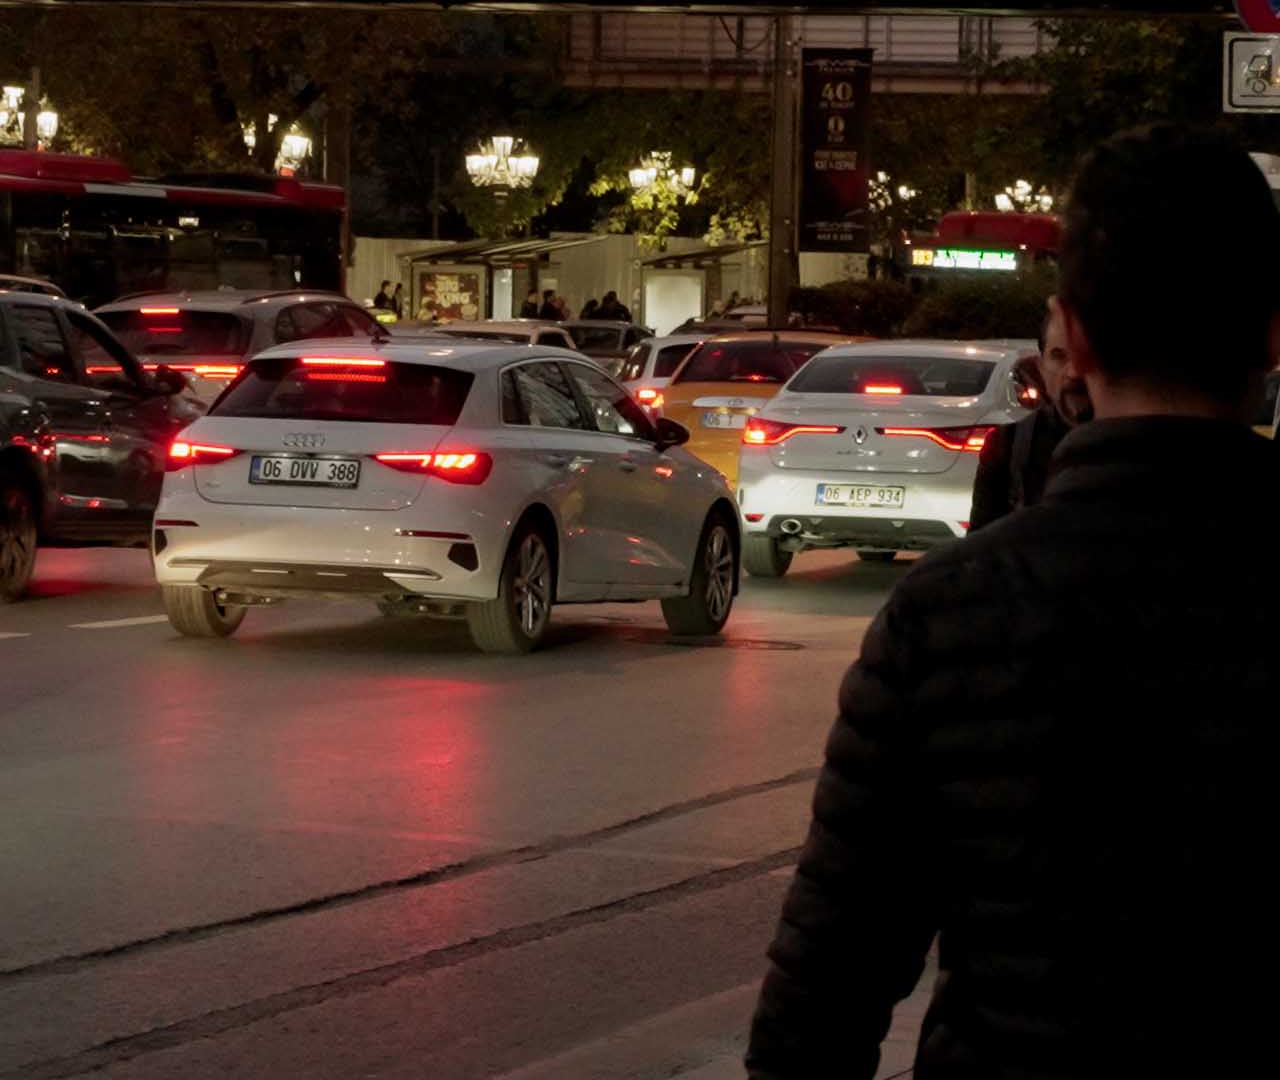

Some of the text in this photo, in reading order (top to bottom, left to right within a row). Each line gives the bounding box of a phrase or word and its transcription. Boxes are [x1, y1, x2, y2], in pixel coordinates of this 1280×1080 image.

[263, 460, 281, 478] 06
[327, 463, 357, 481] 388
[825, 487, 840, 500] 06
